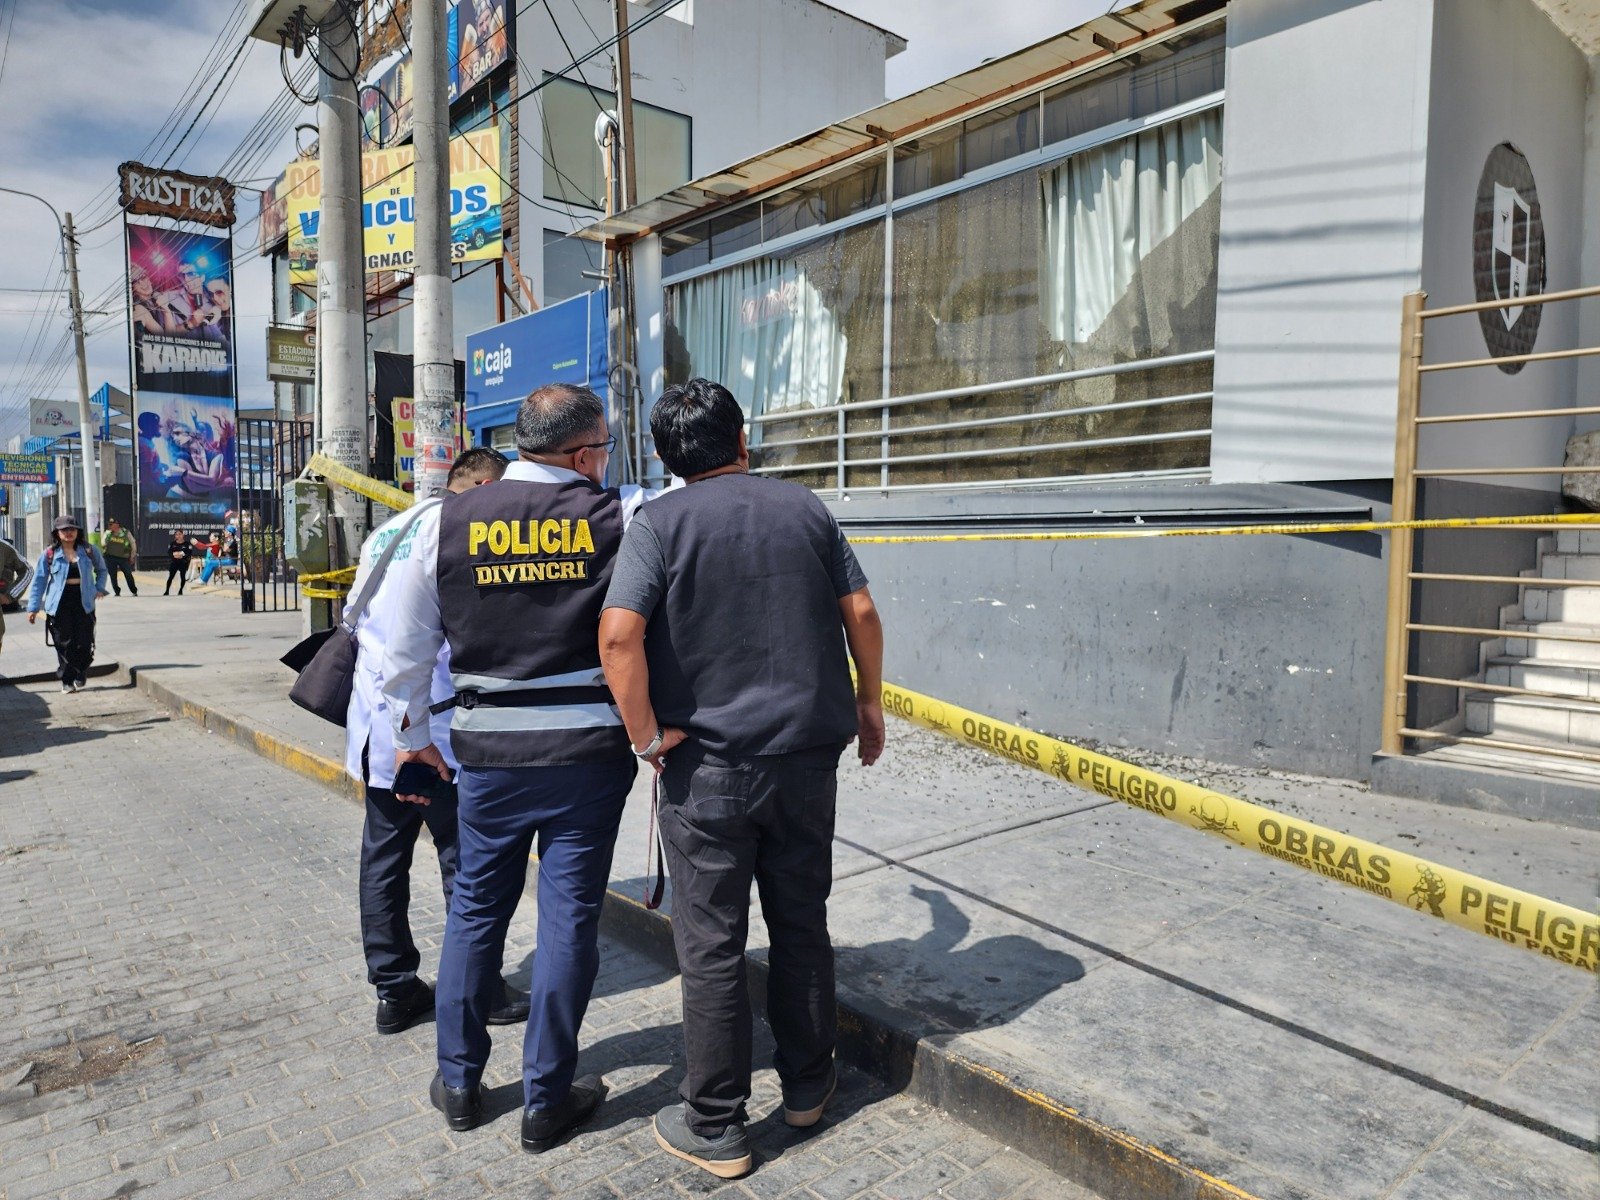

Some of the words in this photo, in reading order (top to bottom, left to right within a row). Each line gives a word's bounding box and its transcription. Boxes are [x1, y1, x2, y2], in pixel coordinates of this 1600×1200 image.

[472, 51, 493, 79] BAR
[290, 154, 391, 201] CORA
[397, 150, 410, 183] Y
[129, 171, 227, 216] RUSTICA
[390, 187, 400, 195] DE
[387, 233, 395, 245] Y
[142, 343, 227, 373] KARAOKE
[485, 343, 511, 374] caja
[1, 474, 42, 482] ENTRADA
[149, 501, 226, 513] DISCOTECA
[475, 560, 586, 585] DIVINCRI
[961, 717, 1039, 761] OBRAS
[1077, 757, 1177, 812] PELIGRO
[1258, 818, 1392, 885] OBRAS
[1259, 841, 1313, 871] HOMBRES
[1314, 861, 1393, 900] TRABAJANDO
[1484, 924, 1517, 945] NO
